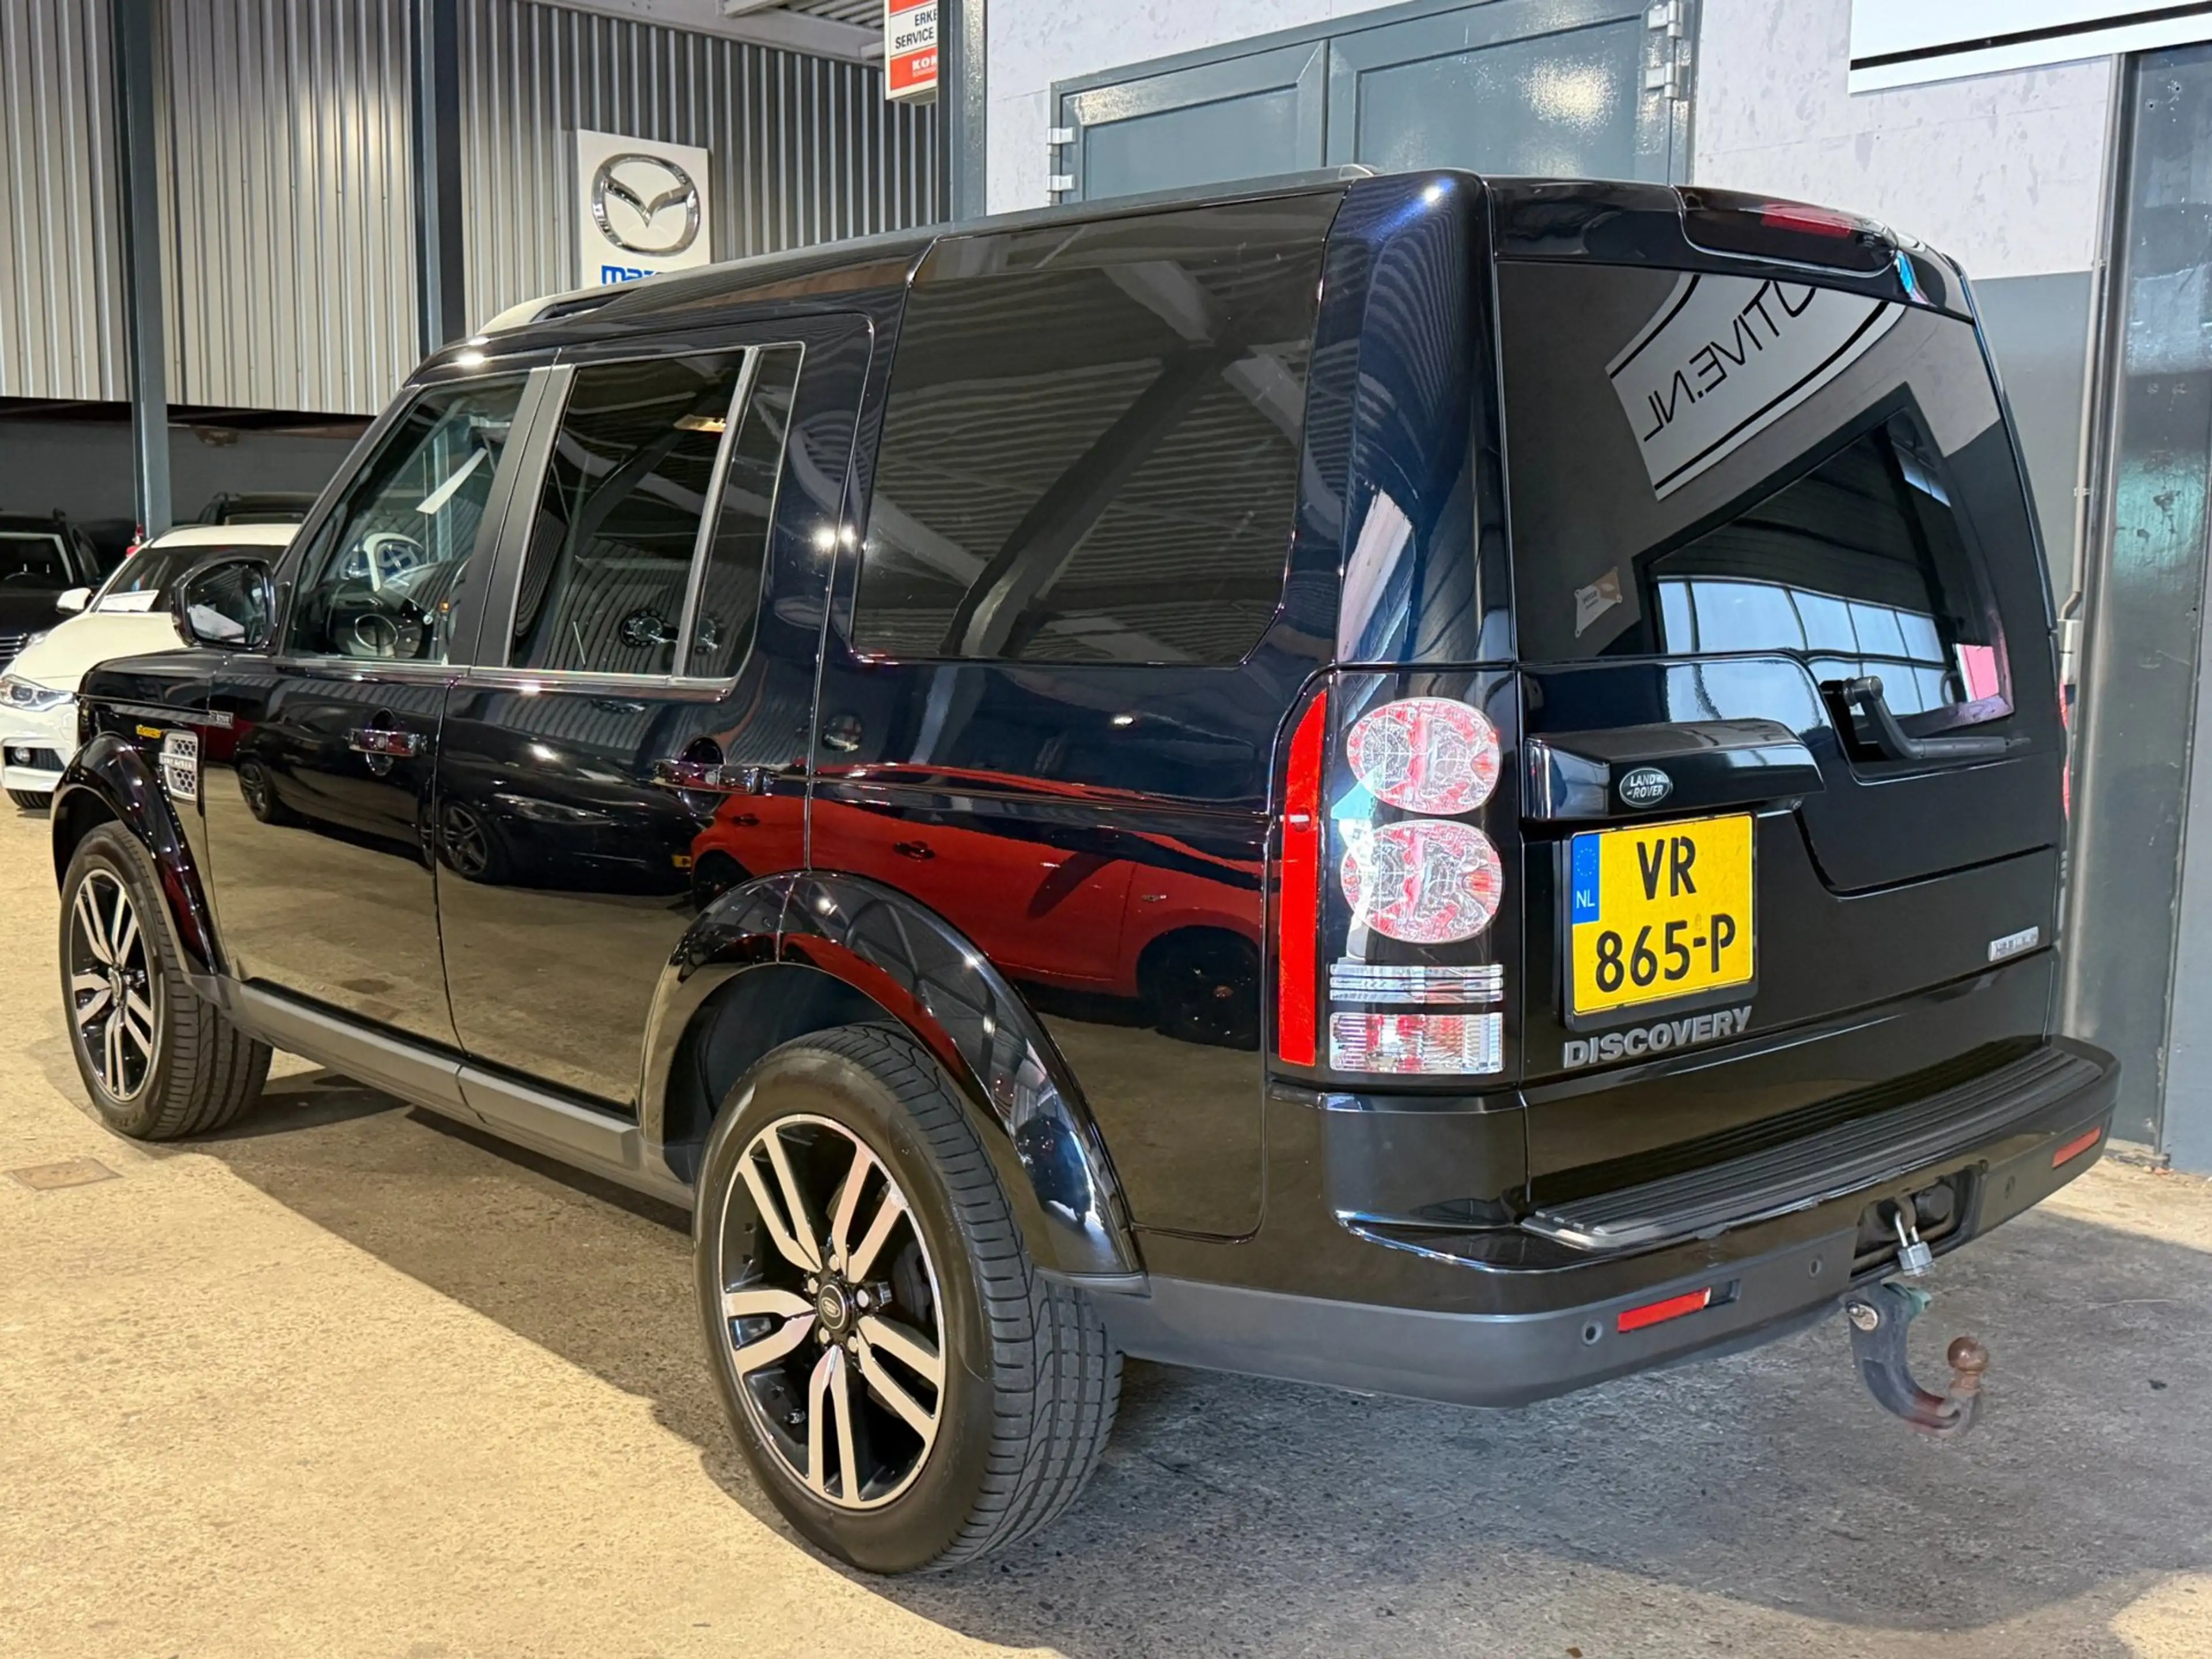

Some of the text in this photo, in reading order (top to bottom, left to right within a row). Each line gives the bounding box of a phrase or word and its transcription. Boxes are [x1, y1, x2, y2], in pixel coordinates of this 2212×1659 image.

[895, 26, 934, 50] SERVICE
[1630, 774, 1656, 787] LAND
[1632, 785, 1664, 799] ROVER
[1637, 836, 1697, 900] VR
[1575, 889, 1596, 909] NL
[1596, 913, 1736, 993] 865-P
[1563, 1006, 1752, 1069] DISCOVERY
